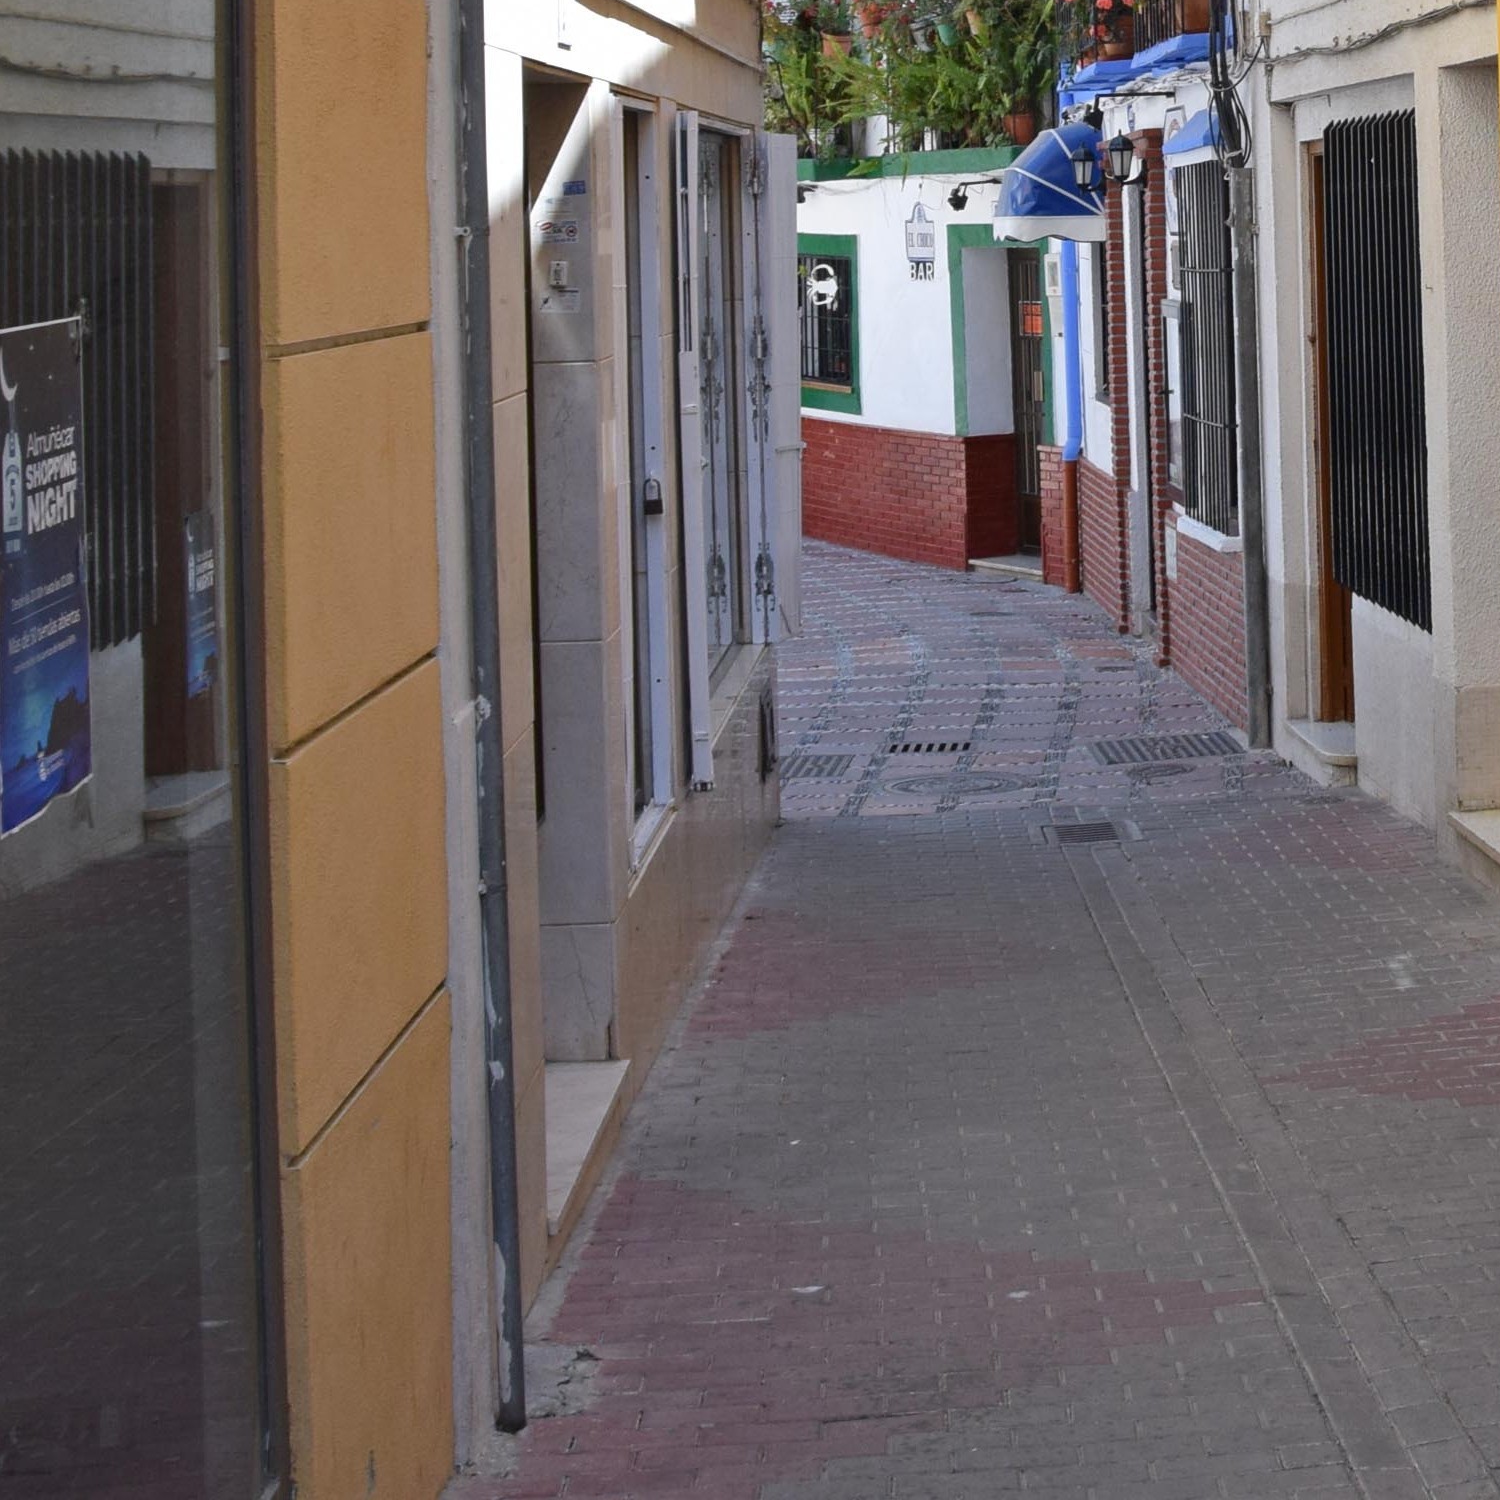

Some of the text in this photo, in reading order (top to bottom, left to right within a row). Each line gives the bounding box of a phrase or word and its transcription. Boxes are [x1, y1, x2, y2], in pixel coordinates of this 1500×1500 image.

[910, 262, 934, 281] BAR
[25, 449, 77, 491] SHOPPING
[27, 479, 77, 535] NIGHT
